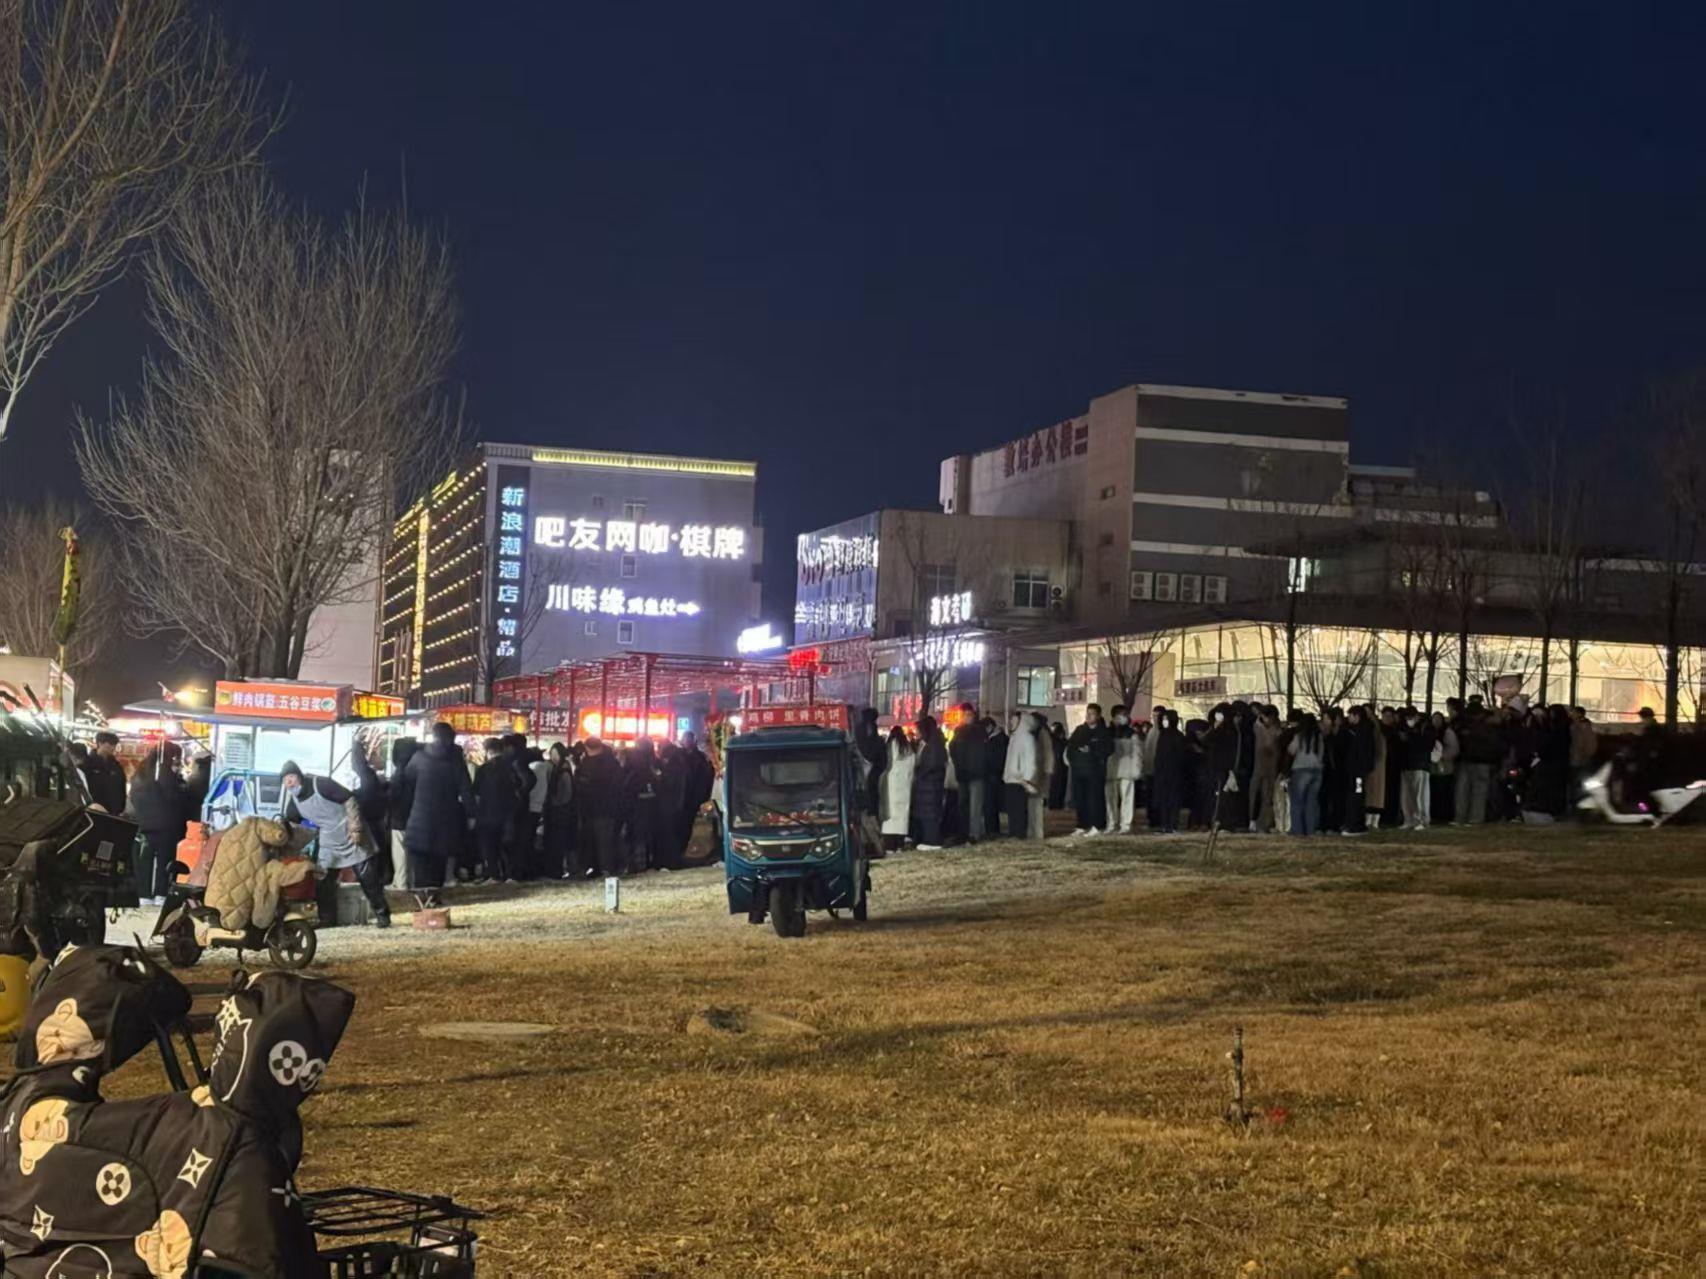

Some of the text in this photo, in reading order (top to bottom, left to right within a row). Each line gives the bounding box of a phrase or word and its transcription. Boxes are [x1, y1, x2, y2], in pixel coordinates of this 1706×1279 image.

[534, 516, 745, 560] 吧友网咖·棋牌
